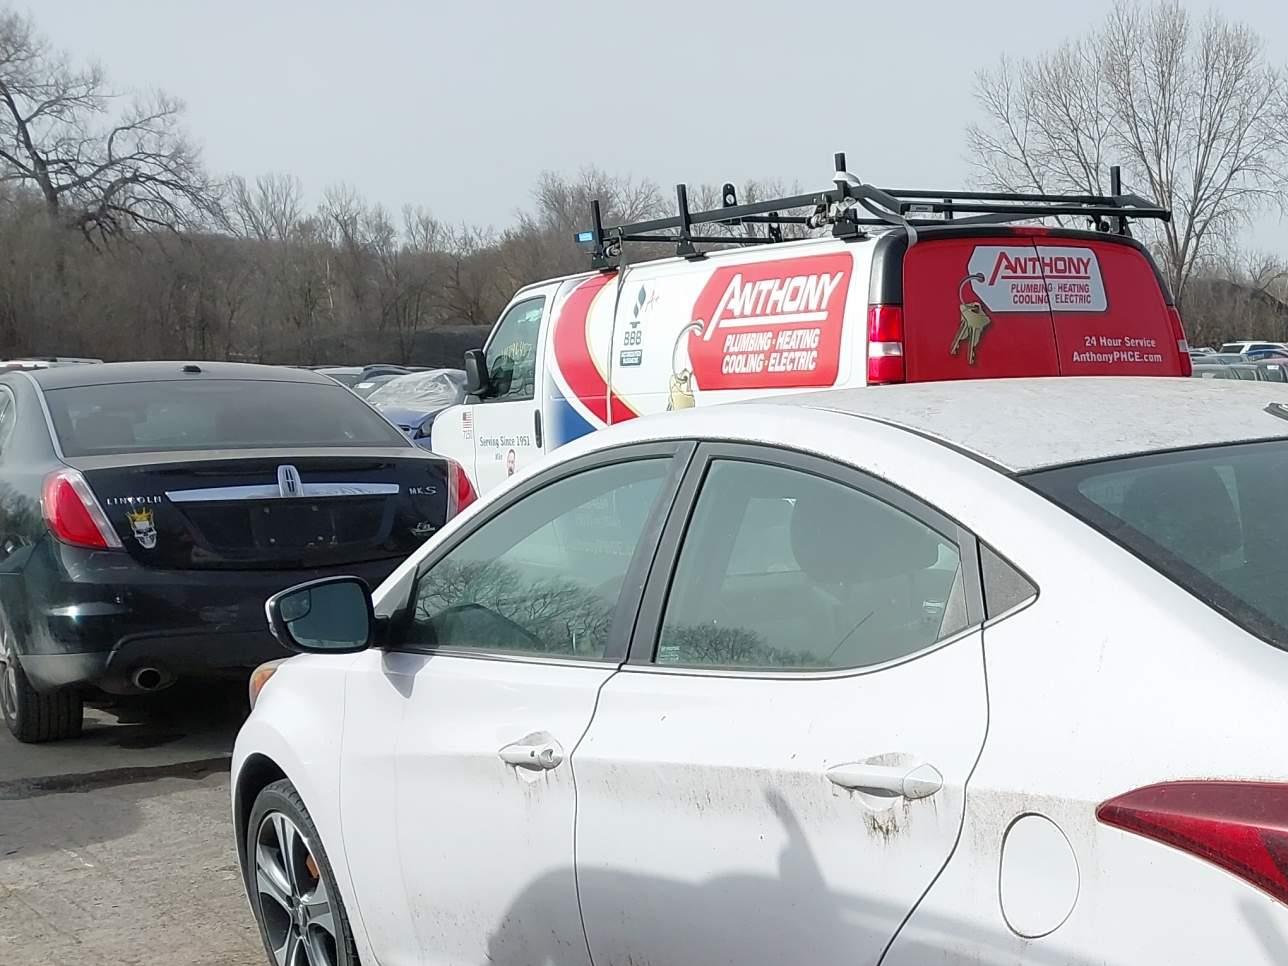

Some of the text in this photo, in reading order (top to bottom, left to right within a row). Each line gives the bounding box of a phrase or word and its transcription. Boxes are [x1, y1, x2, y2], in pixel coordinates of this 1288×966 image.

[987, 251, 1091, 286] ANTHONY
[1011, 282, 1090, 294] PLUMBING HEATING
[703, 271, 844, 341] ANTHONY
[1055, 294, 1092, 305] ELECTRIC
[723, 328, 821, 352] PLUMBING HEATING
[1084, 336, 1157, 348] 24 Hour Service
[721, 350, 818, 374] COOLING ELECTRIC
[1072, 351, 1162, 364] AnthonyPHCE.com
[479, 434, 531, 449] Serving Since 1951
[408, 485, 438, 496] MKS
[106, 495, 162, 506] LINCOLN
